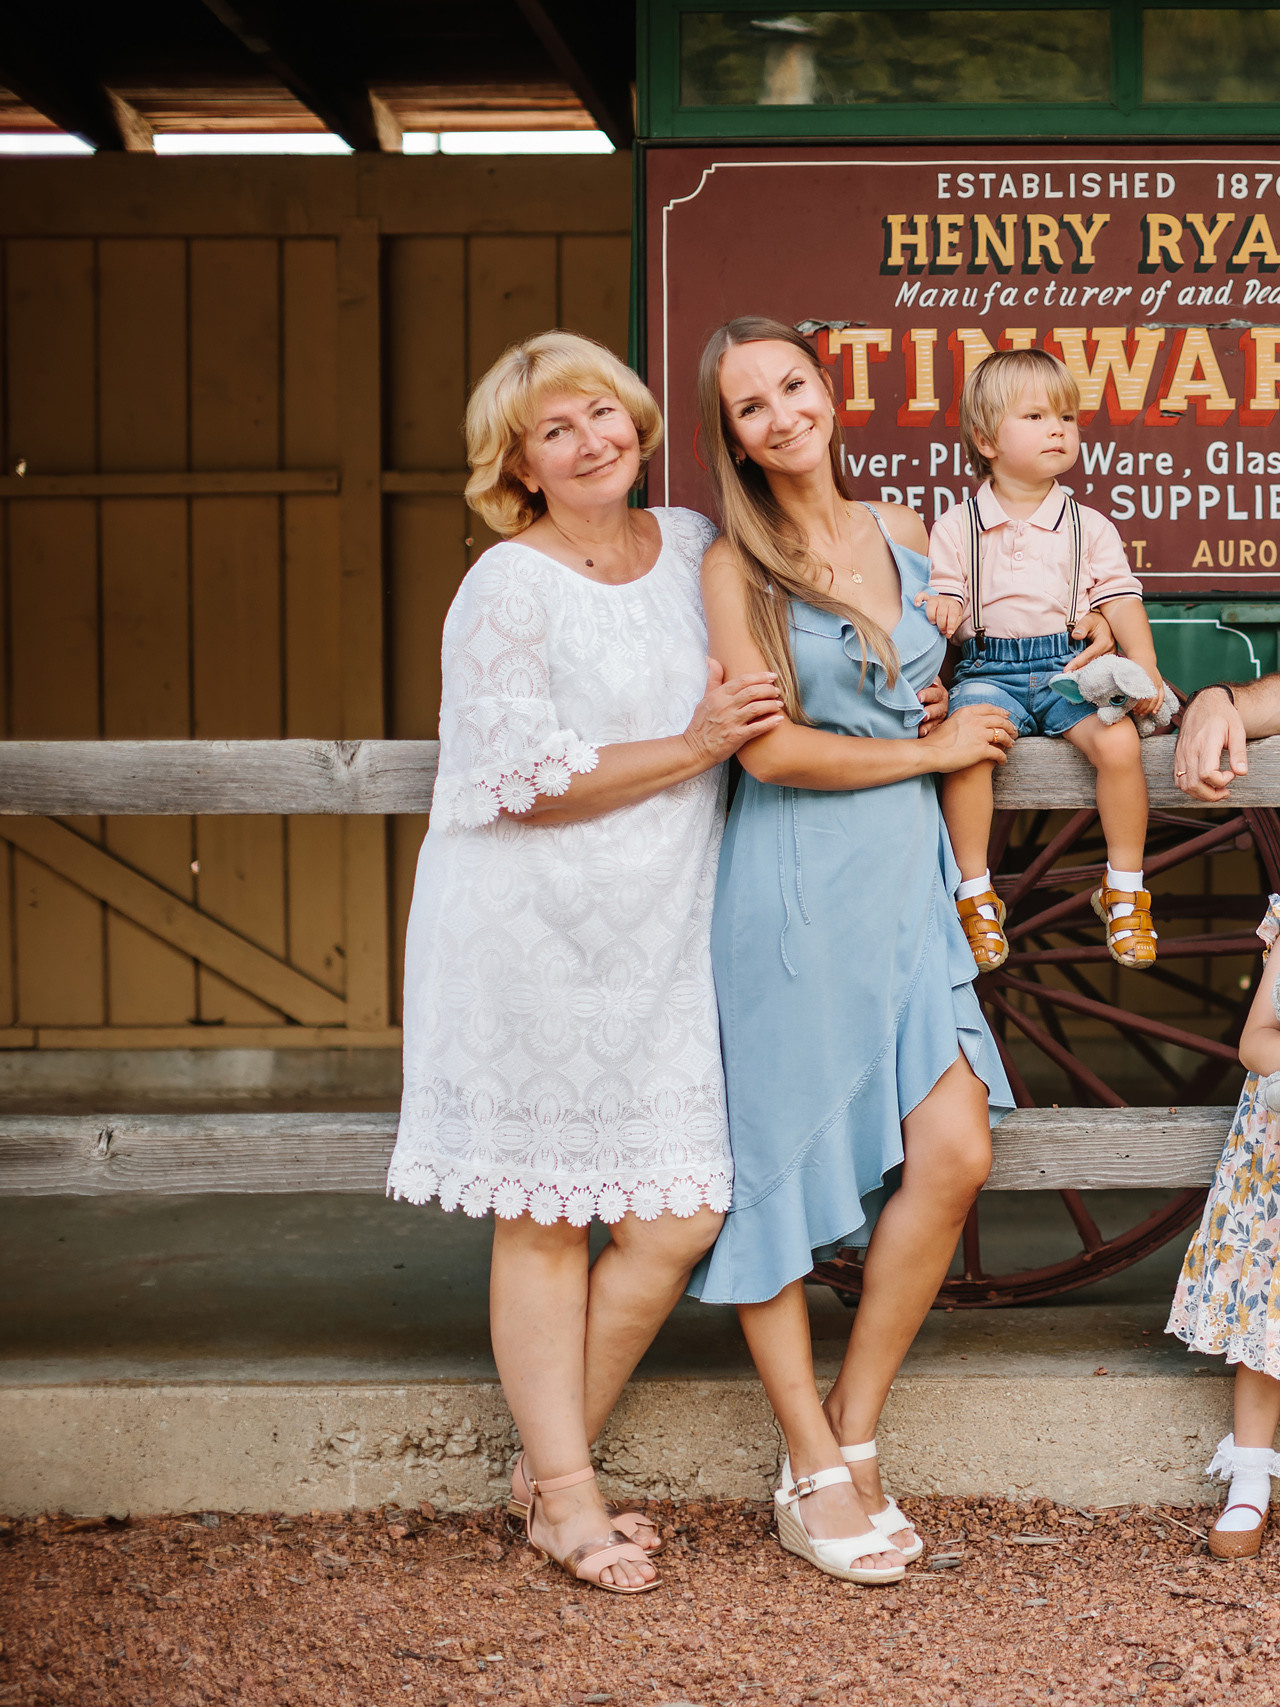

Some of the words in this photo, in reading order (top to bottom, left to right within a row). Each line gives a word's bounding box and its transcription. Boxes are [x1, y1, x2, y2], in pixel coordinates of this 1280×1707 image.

[936, 172, 1176, 200] ESTABLISHED
[882, 213, 1111, 273] HENRY
[894, 280, 1133, 316] Manufacturer
[1140, 279, 1173, 316] of
[1177, 279, 1234, 306] and
[1119, 540, 1152, 568] T.
